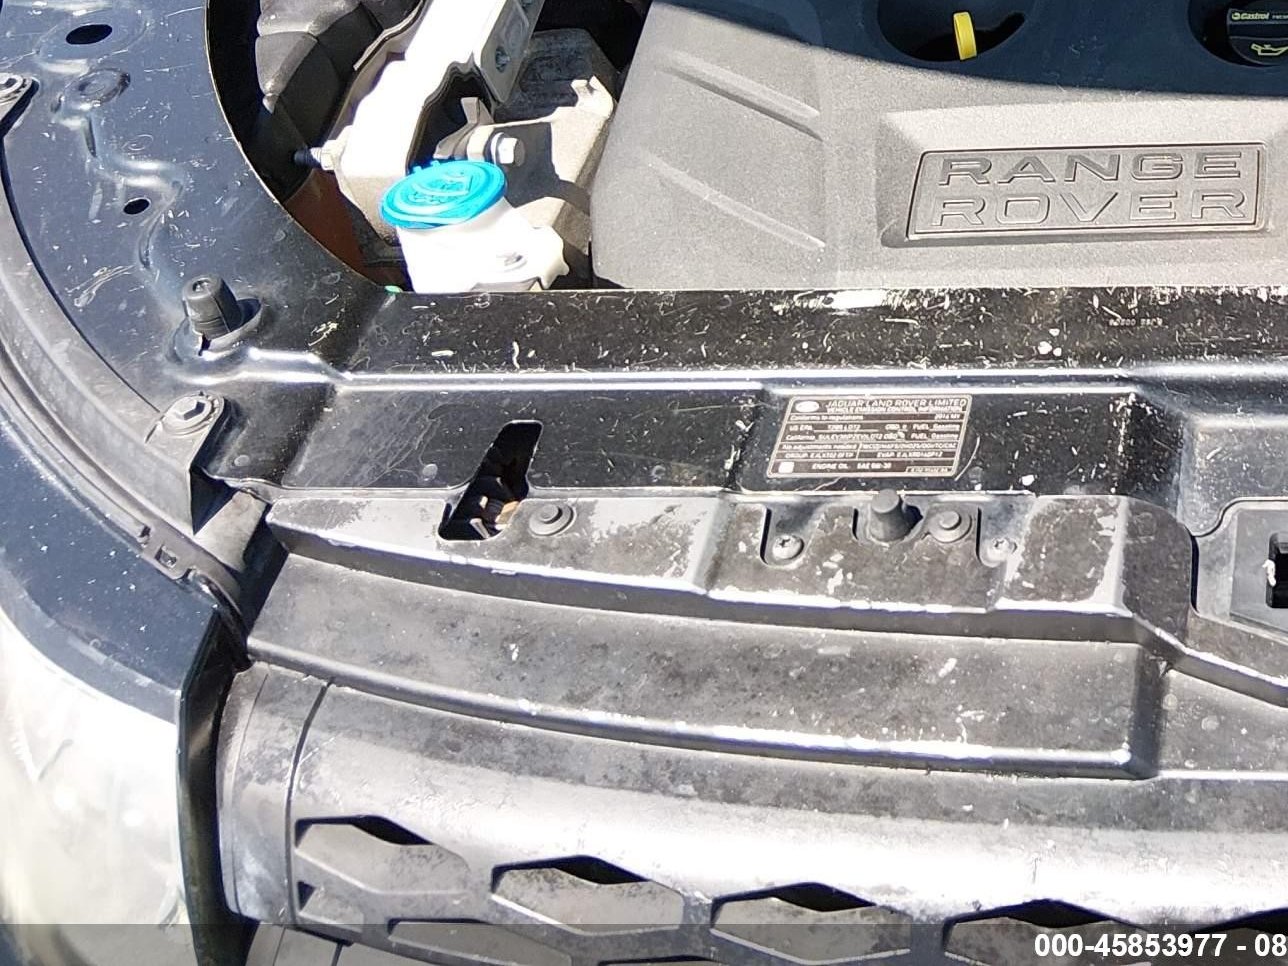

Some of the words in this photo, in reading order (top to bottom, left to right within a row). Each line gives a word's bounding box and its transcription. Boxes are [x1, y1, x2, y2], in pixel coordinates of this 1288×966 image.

[938, 151, 1242, 186] RANGE
[932, 189, 1246, 226] ROVER
[826, 400, 864, 408] JAGUAR
[866, 399, 892, 407] LAND
[895, 399, 927, 407] ROVER
[929, 399, 967, 407] LIMITED
